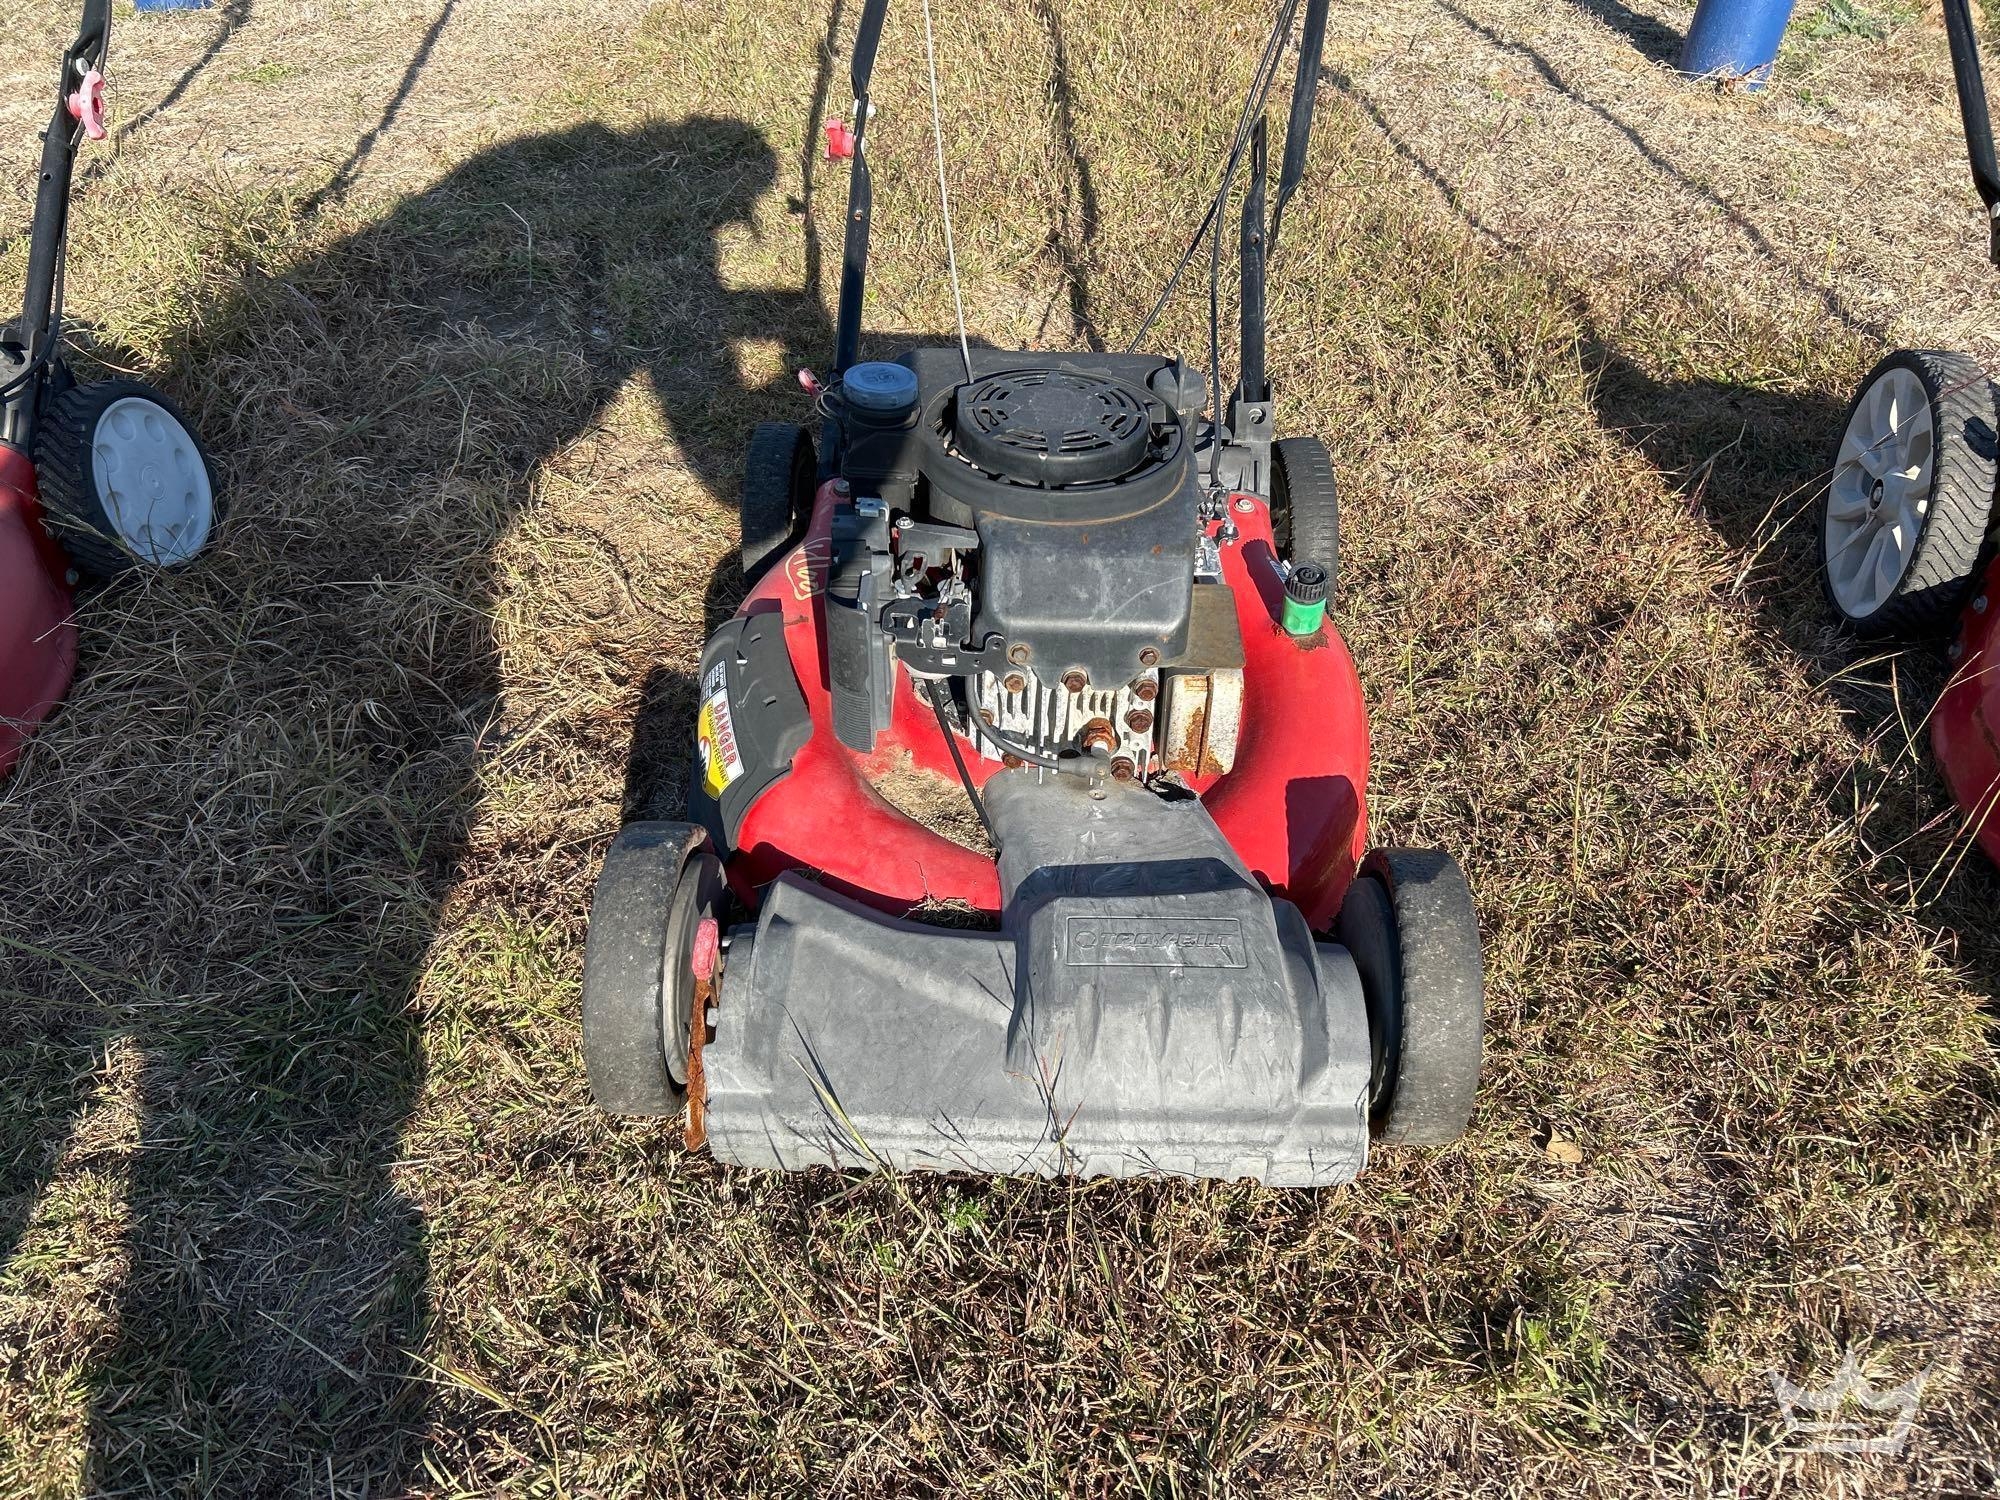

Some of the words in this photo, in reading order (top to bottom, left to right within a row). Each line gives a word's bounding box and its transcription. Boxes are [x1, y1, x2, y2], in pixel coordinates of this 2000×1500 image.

[708, 718, 717, 739] HANDS
[714, 701, 737, 768] DANGER
[714, 748, 723, 765] FEET
[718, 764, 728, 784] AWAY
[1101, 932, 1234, 949] TROY-BILT
